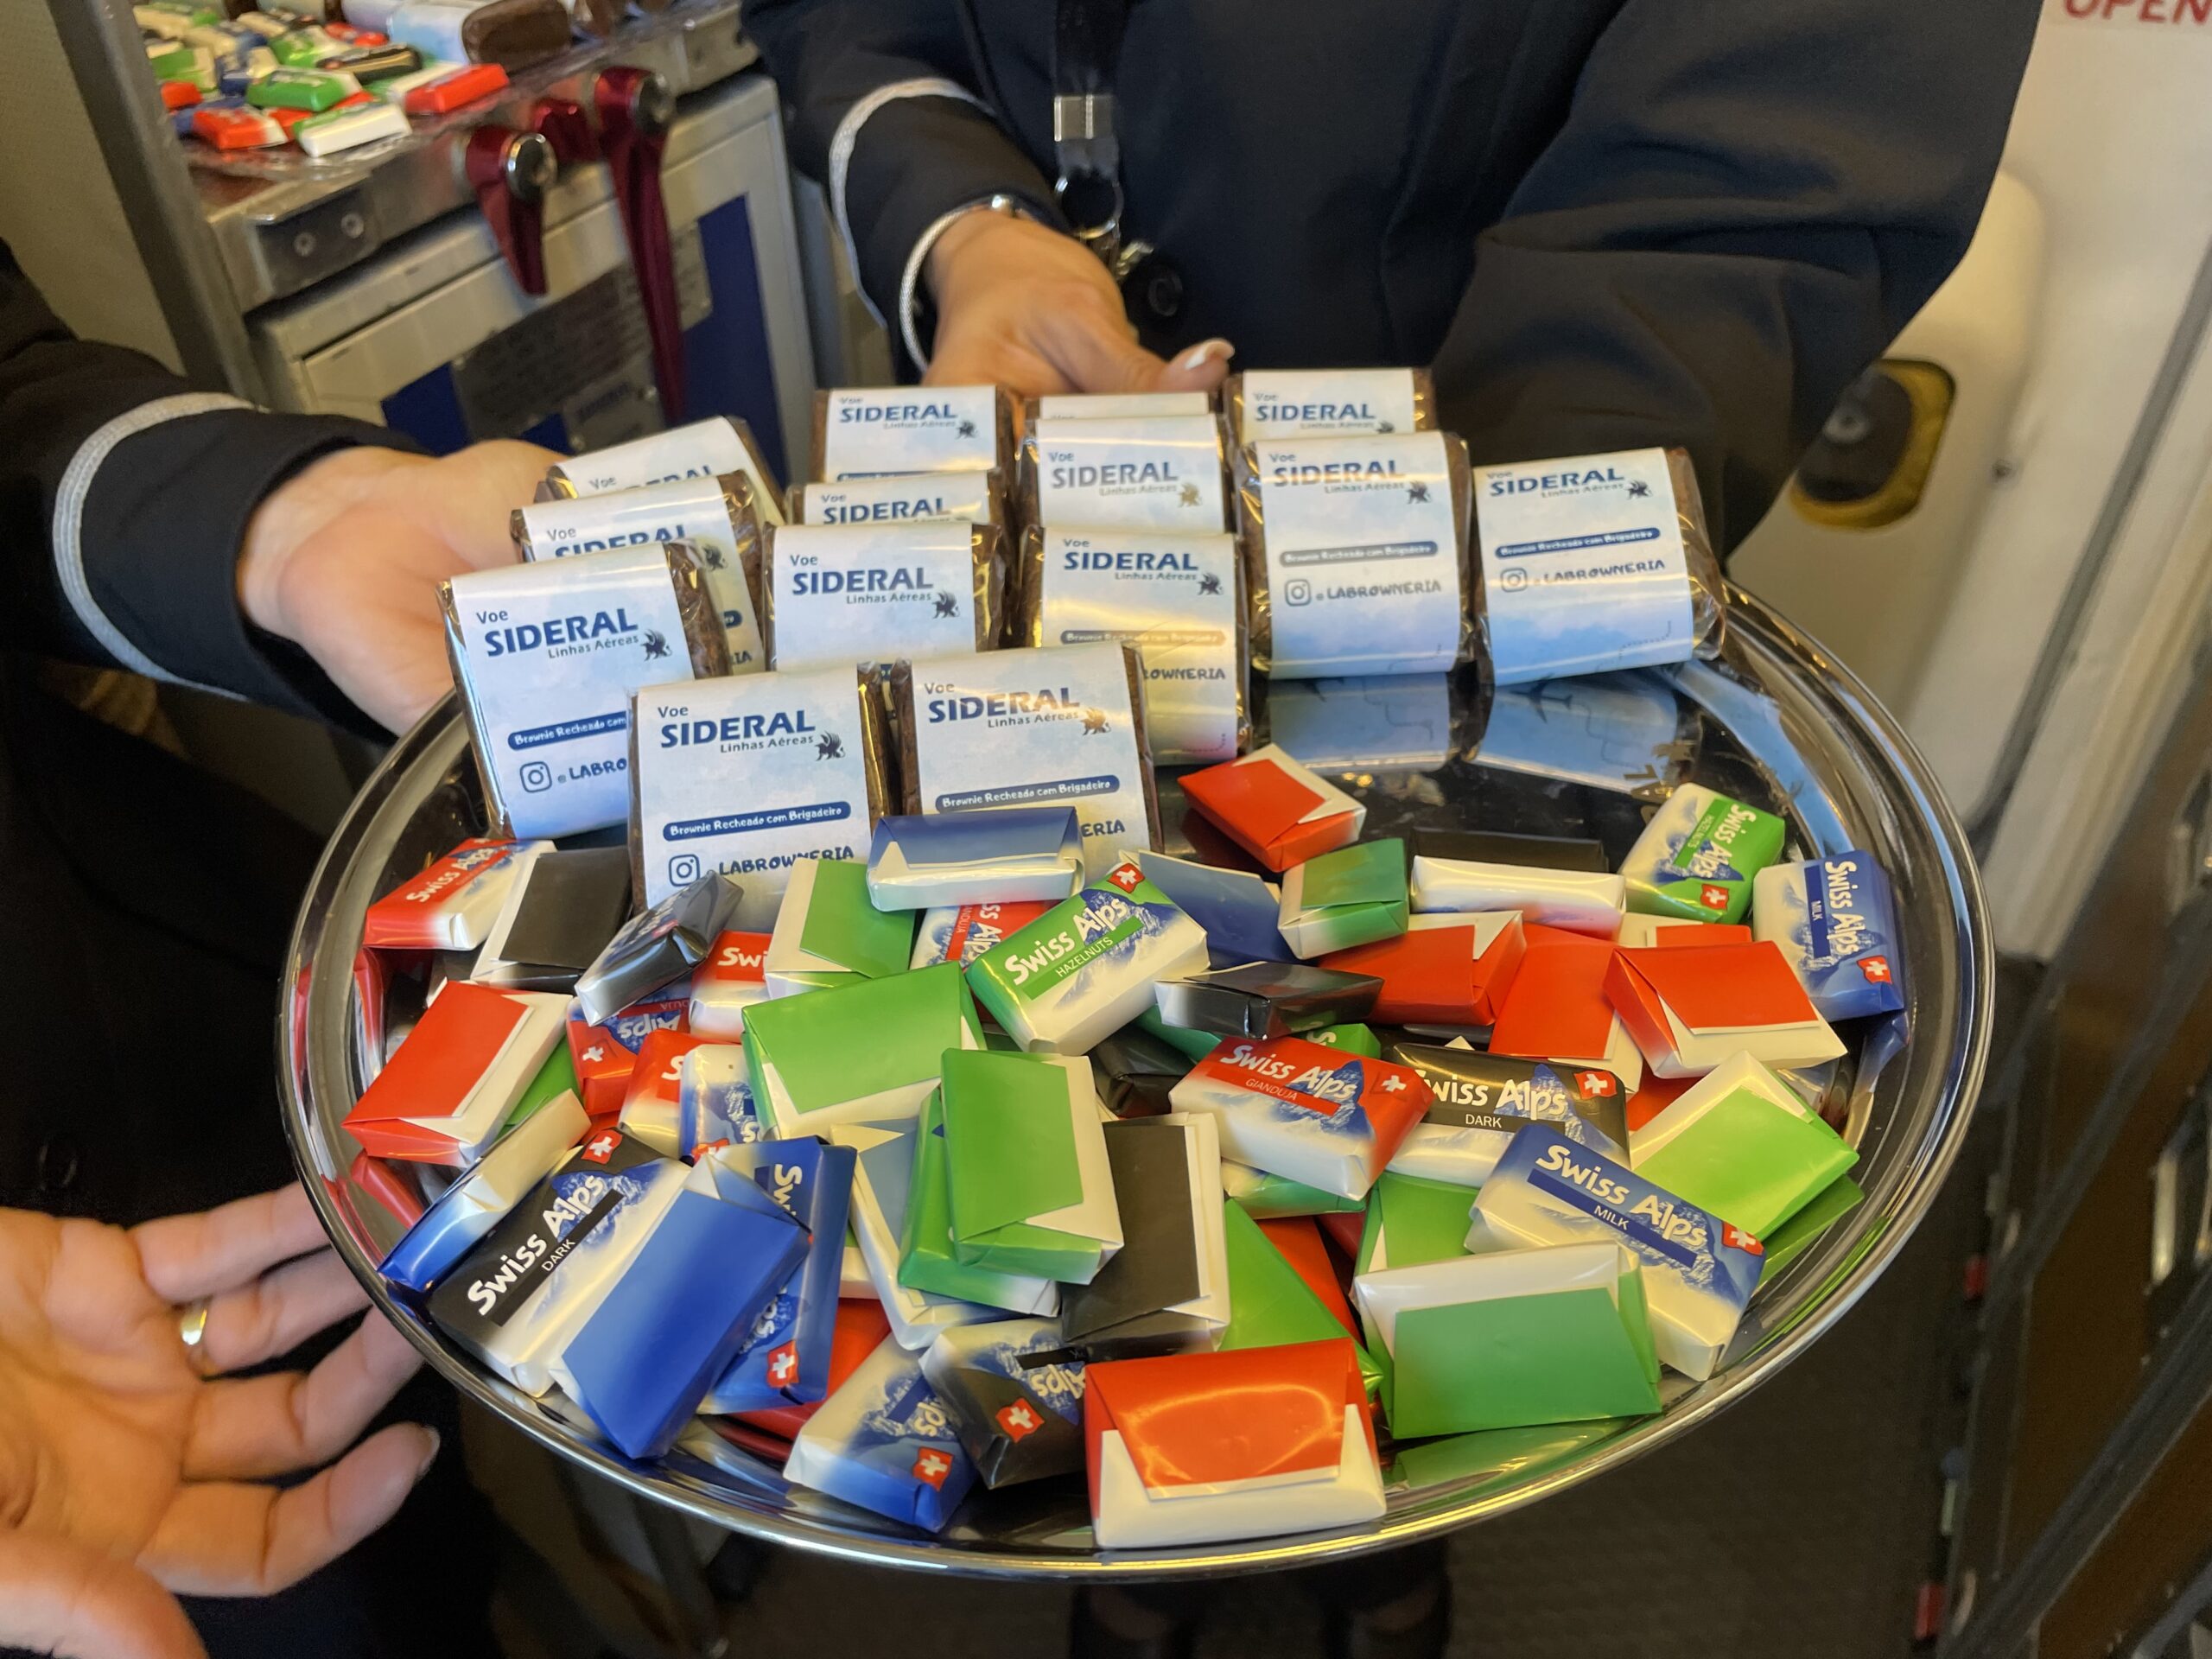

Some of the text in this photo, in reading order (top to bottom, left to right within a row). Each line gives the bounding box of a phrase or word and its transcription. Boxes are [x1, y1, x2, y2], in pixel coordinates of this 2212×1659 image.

[839, 404, 957, 423] SIDERAL
[1255, 404, 1376, 422] SIDERAL
[1048, 451, 1074, 462] Voe
[1268, 453, 1296, 463] Voe
[589, 477, 616, 490] Voe
[1052, 461, 1179, 490] SIDERAL
[1273, 460, 1406, 487] SIDERAL
[1491, 467, 1624, 498] SIDERAL
[820, 493, 846, 503] Voe
[823, 498, 952, 524] SIDERAL
[547, 526, 577, 542] Voe
[1063, 538, 1090, 548] Voe
[790, 554, 818, 566] Voe
[1064, 551, 1198, 570] SIDERAL
[792, 567, 933, 596] SIDERAL
[1115, 572, 1153, 581] Linhas
[847, 592, 931, 604] Linhas Aéreas
[476, 610, 509, 624] Voe
[485, 608, 639, 657] SIDERAL
[548, 635, 639, 658] Linhas Aéreas
[924, 683, 955, 695] Voe
[658, 706, 689, 718] Voe
[929, 687, 1080, 724] SIDERAL
[661, 709, 816, 748] SIDERAL
[988, 710, 1079, 728] Linhas Aéreas
[514, 730, 555, 746] Brownie
[556, 719, 605, 737] Recheado
[720, 735, 814, 753] Linhas Aéreas
[942, 779, 1110, 808] Brownie Recheado com Brigadeiro
[670, 807, 842, 836] Brownie Recheado com Brigadeiro
[1694, 804, 1757, 878] Swiss Alps
[1811, 900, 1823, 921] MILK
[1825, 861, 1866, 955] Swiss Alps
[1005, 897, 1128, 985] Swiss Alps
[1056, 938, 1114, 977] HAZELNUTS
[1221, 1045, 1357, 1099] Swiss Alps
[1245, 1077, 1298, 1102] GIANDUJA
[1414, 1069, 1567, 1121] wiss Alps
[1465, 1113, 1503, 1128] DARK
[1535, 1145, 1707, 1248] Swiss Alps
[1593, 1205, 1629, 1231] MILK
[467, 1174, 605, 1316] Swiss Alps
[541, 1238, 576, 1272] DARK
